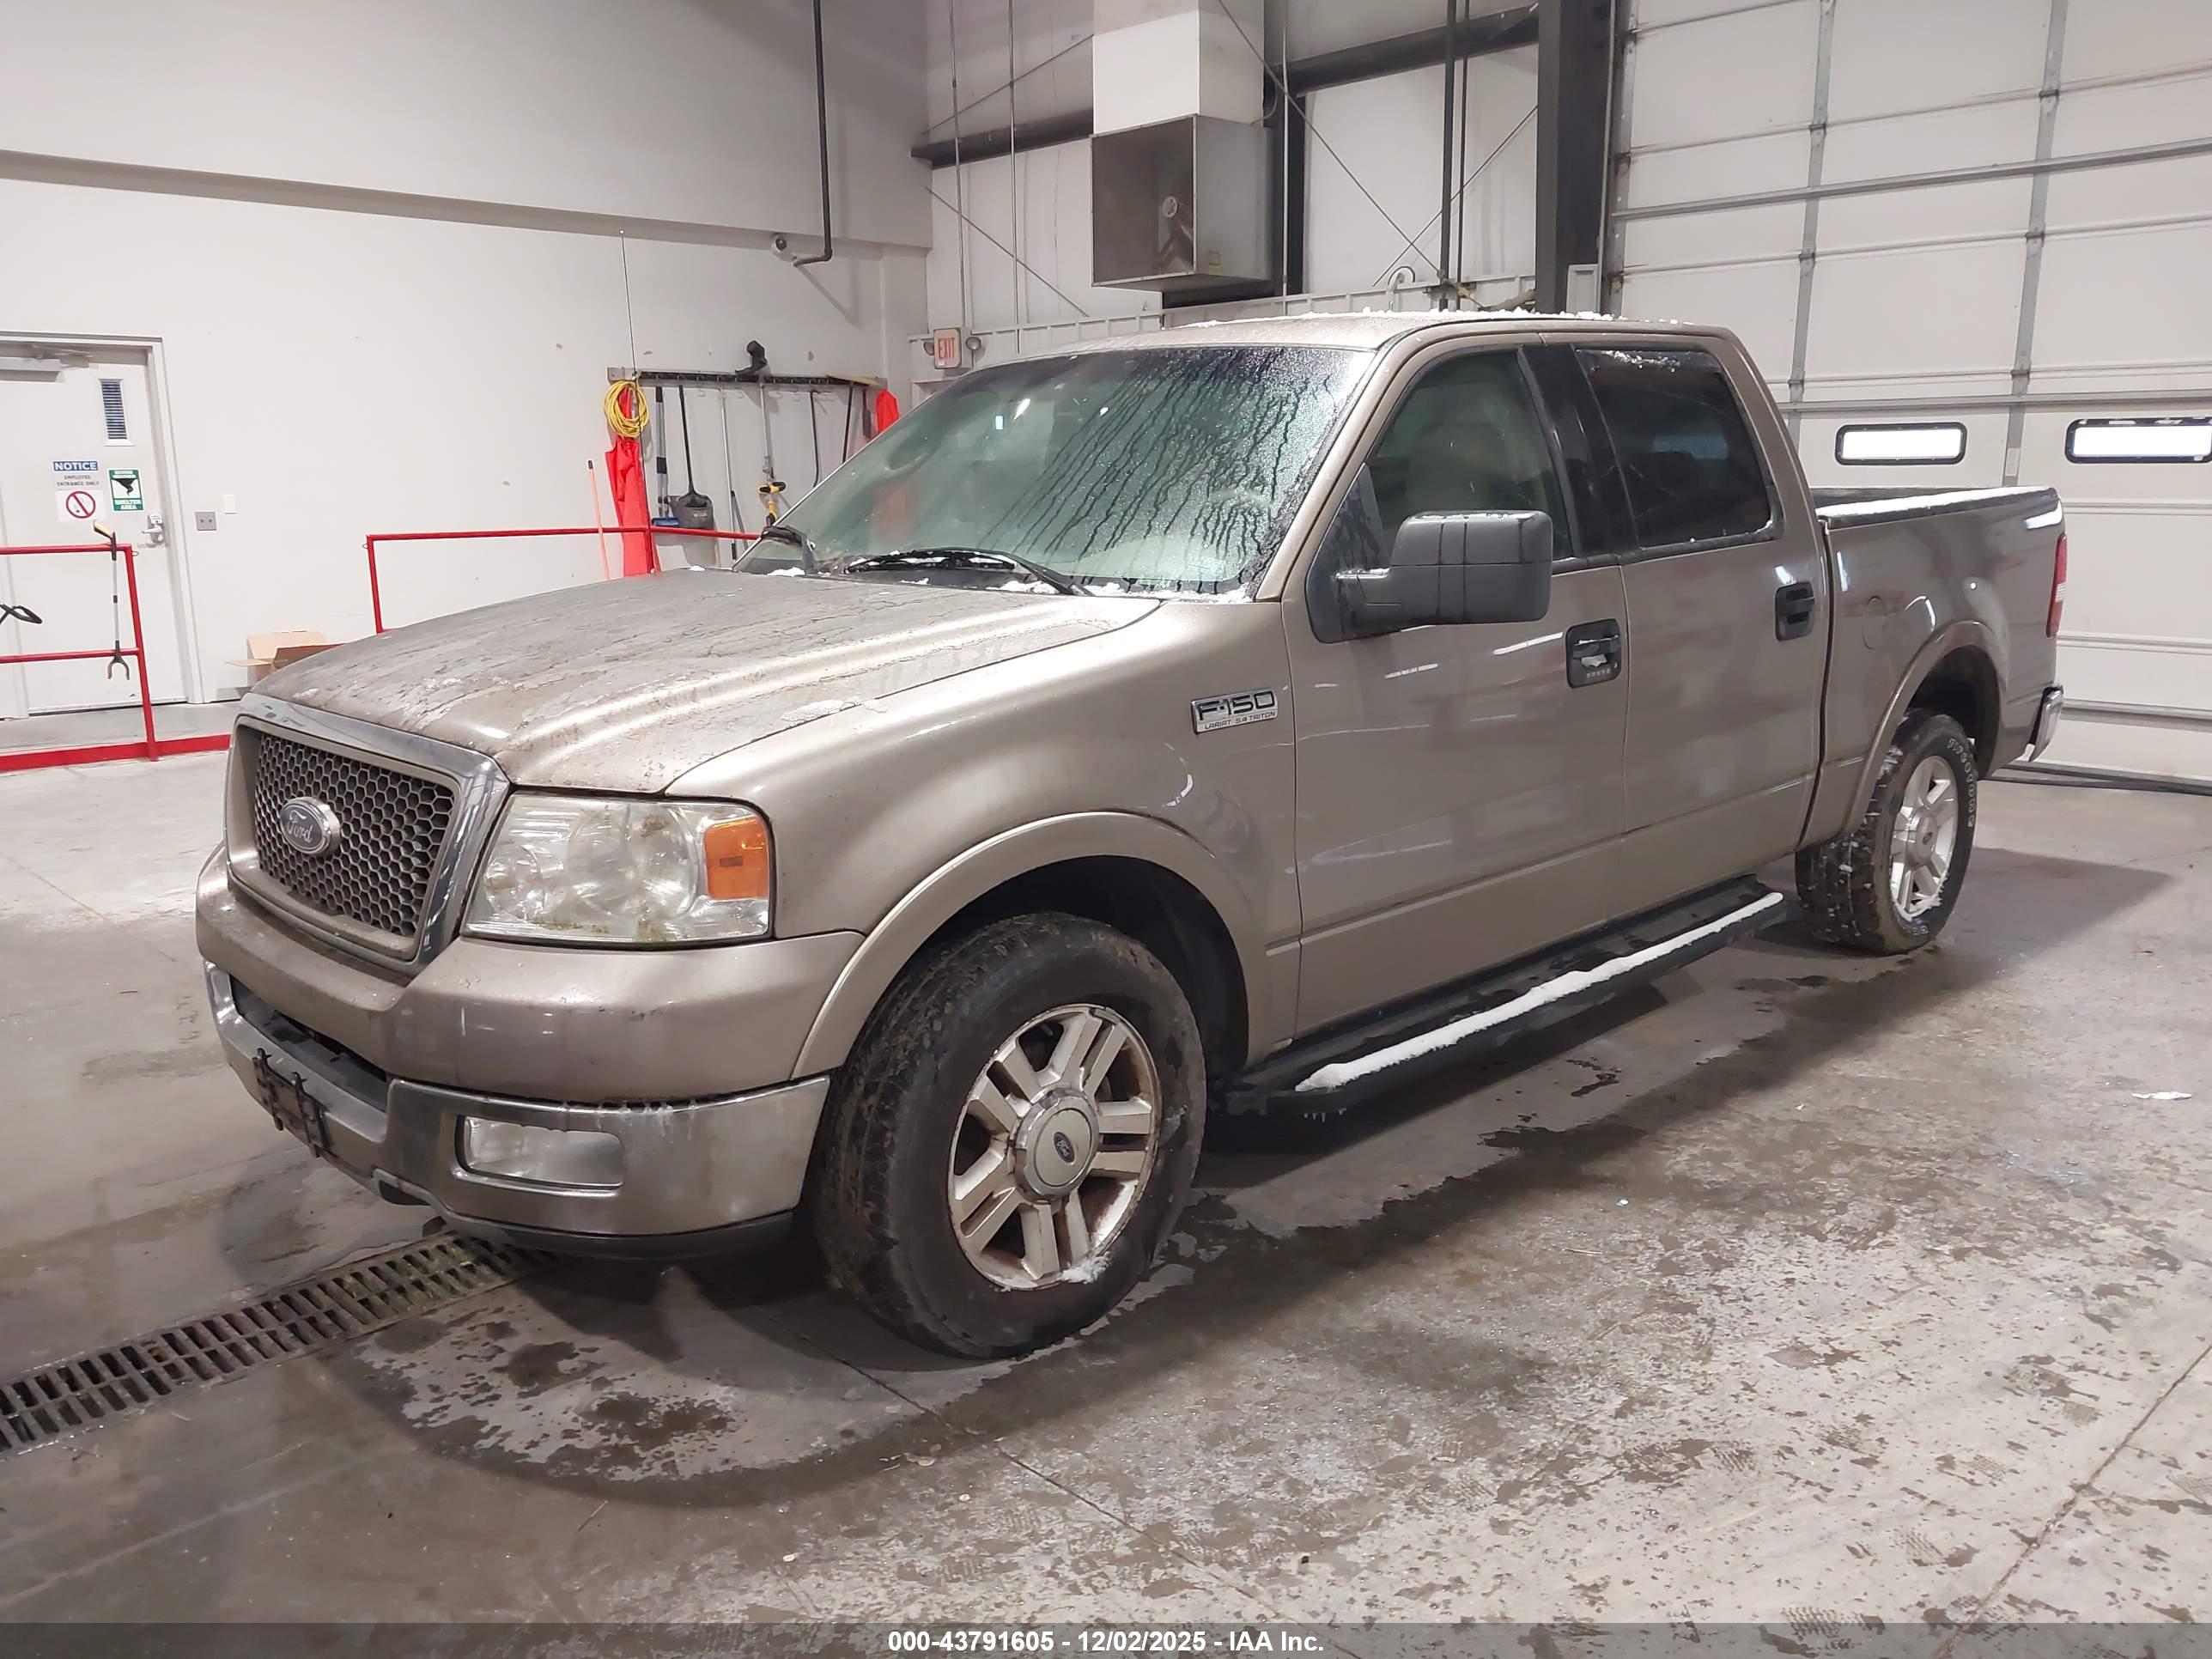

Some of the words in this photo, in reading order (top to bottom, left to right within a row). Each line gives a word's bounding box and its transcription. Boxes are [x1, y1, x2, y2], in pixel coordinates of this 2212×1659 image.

[938, 337, 955, 360] EXIT
[54, 462, 97, 471] NOTICE
[1204, 719, 1231, 730] LARIAT
[1249, 710, 1276, 721] TRITON
[286, 809, 314, 844] Ford
